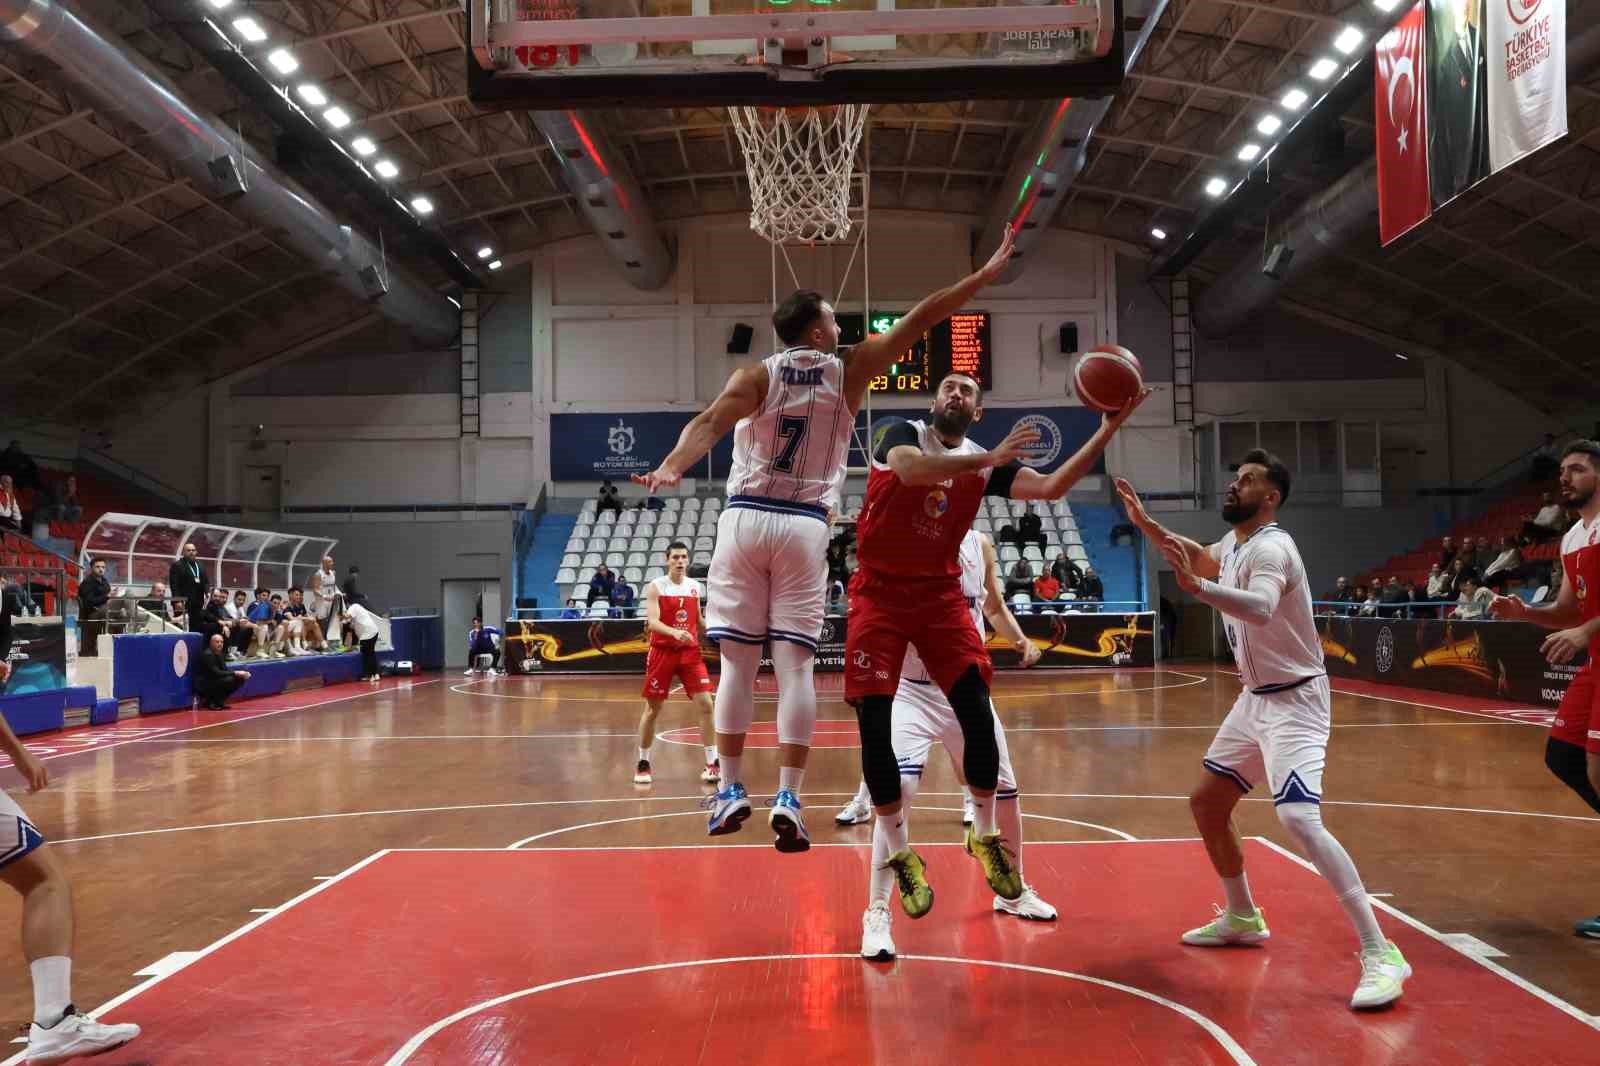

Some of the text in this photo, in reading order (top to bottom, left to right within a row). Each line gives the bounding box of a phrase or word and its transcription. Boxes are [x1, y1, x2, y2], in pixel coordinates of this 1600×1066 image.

[1505, 15, 1550, 58] TÜRKİYE
[873, 318, 890, 335] 45
[773, 415, 808, 473] 7
[679, 598, 685, 608] 7
